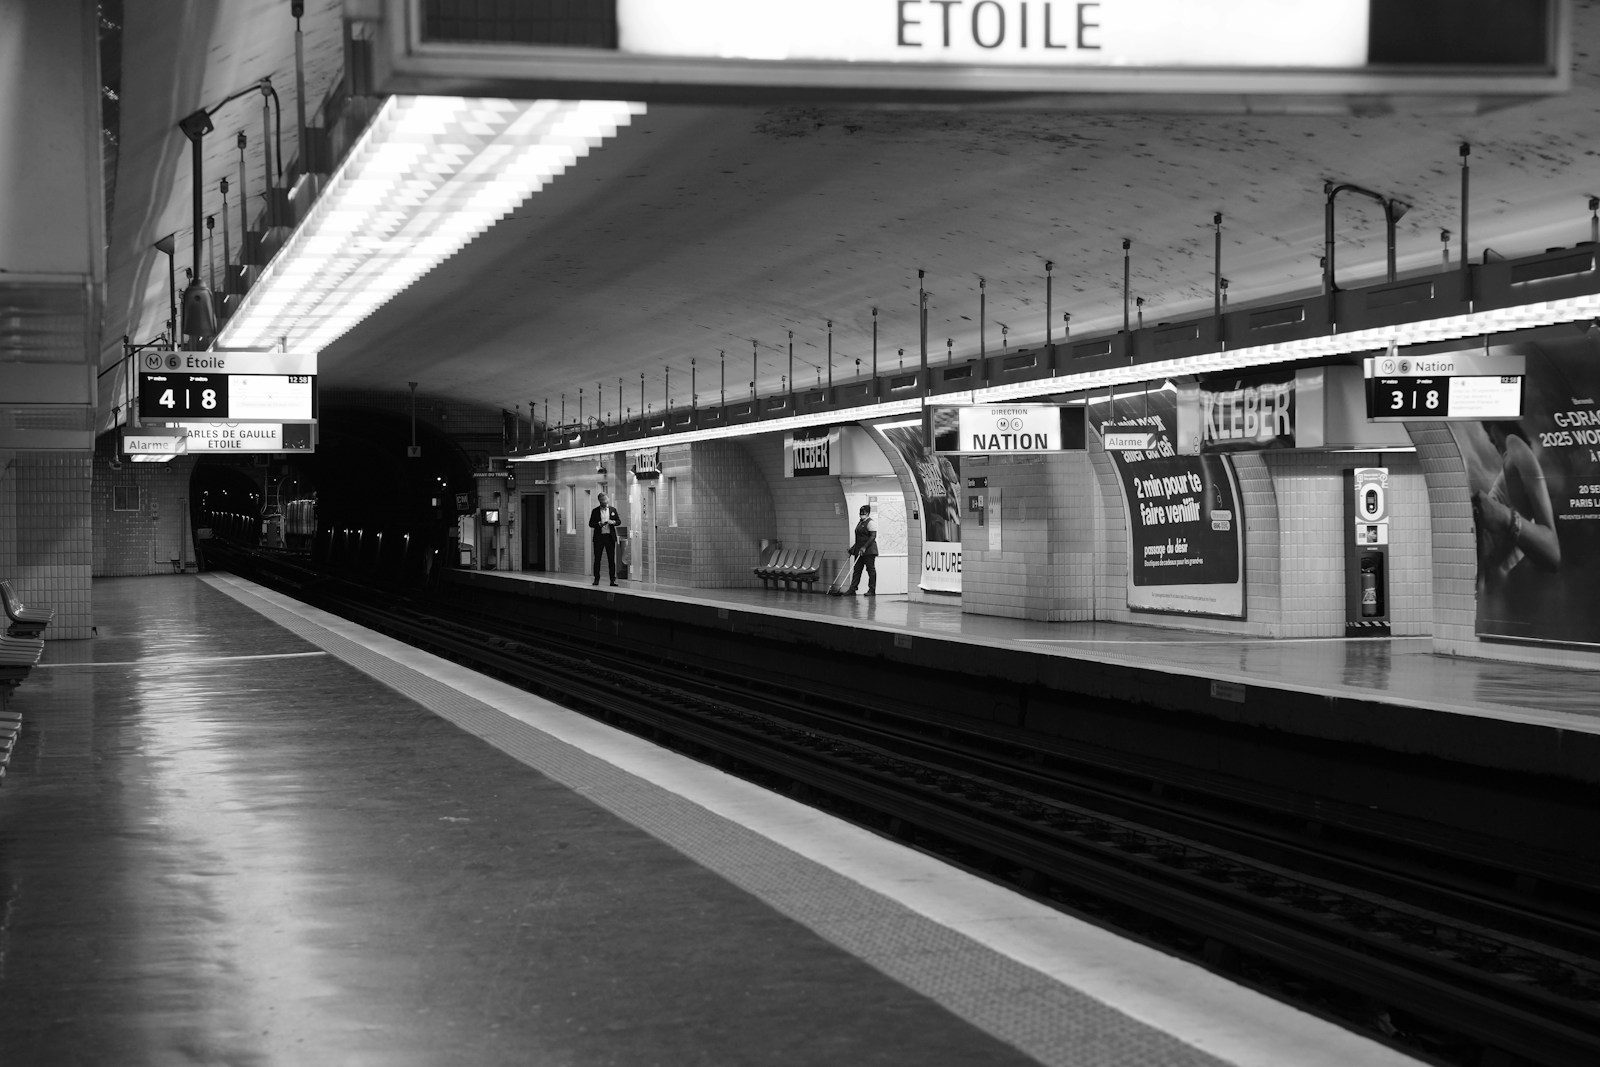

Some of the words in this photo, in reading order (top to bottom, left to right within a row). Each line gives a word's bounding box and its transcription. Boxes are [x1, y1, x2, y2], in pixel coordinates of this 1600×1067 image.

[897, 0, 1101, 49] ETOILE
[187, 354, 225, 368] Étoile
[1416, 361, 1454, 371] Nation
[159, 388, 176, 409] 4
[201, 388, 217, 410] 8
[1390, 390, 1404, 409] 3
[1425, 390, 1439, 410] 8
[1203, 380, 1291, 440] KLÉBER
[222, 430, 236, 438] DE
[239, 430, 276, 438] GAULLE
[973, 434, 1048, 450] NATION
[1108, 438, 1142, 446] Alarme
[1539, 431, 1573, 447] 2025
[129, 440, 168, 450] Alarme
[208, 440, 242, 449] ETOILE
[1134, 477, 1145, 498] 2
[1142, 473, 1165, 497] min
[1162, 474, 1188, 500] pour
[1187, 470, 1203, 493] te
[1569, 499, 1593, 507] PARIS
[1140, 501, 1166, 526] faire
[1144, 545, 1166, 558] passage
[1167, 538, 1174, 554] du
[1174, 537, 1188, 553] désir
[925, 551, 962, 573] CULTURE
